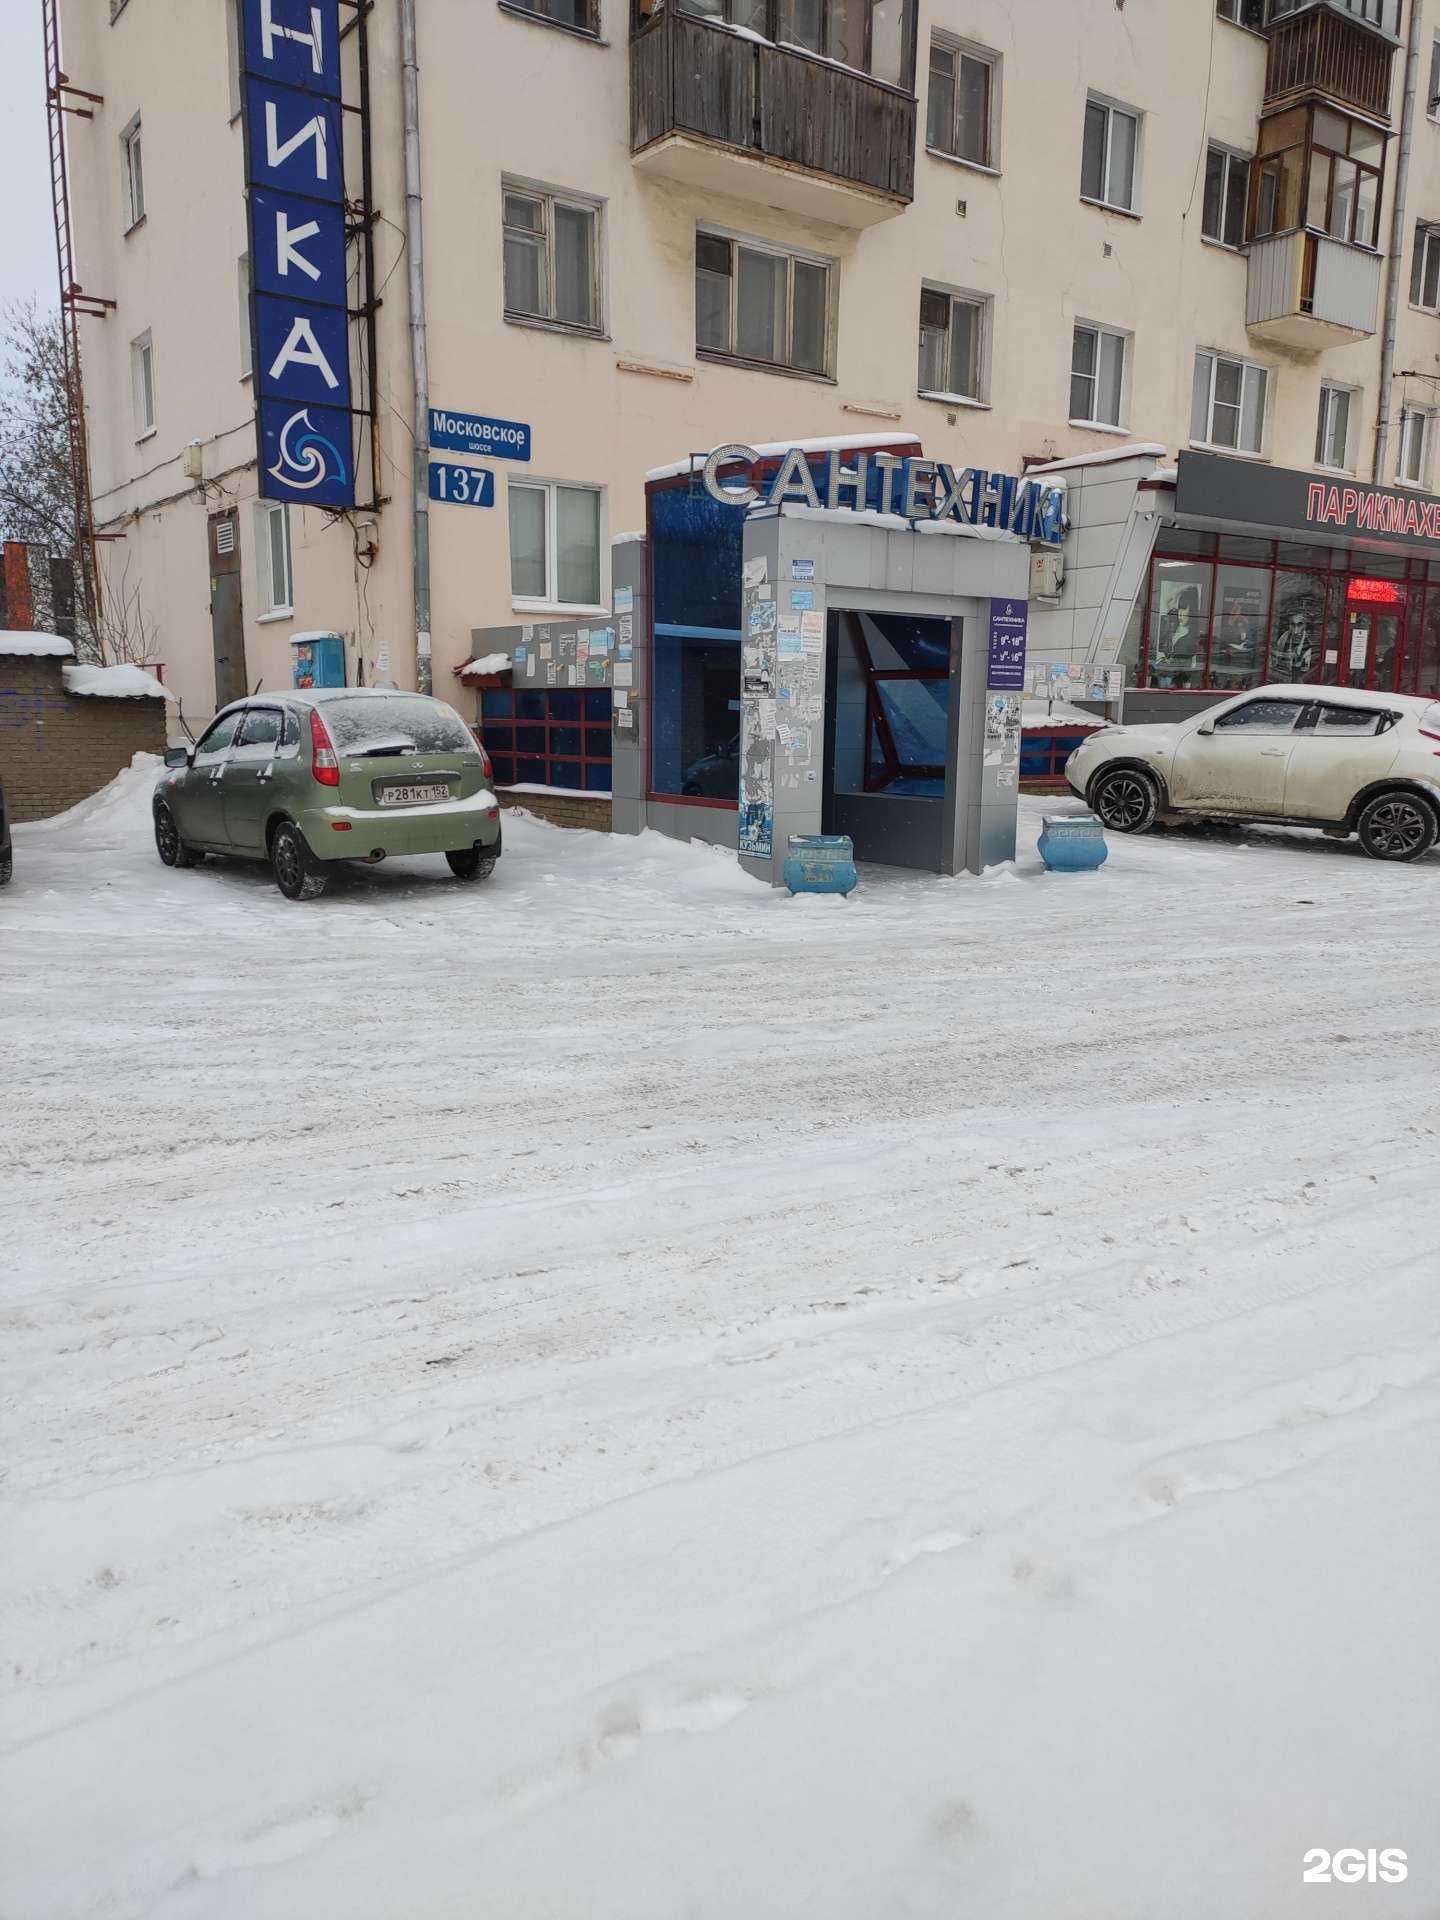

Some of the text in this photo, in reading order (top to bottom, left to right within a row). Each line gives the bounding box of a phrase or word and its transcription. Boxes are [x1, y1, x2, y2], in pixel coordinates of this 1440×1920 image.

[433, 412, 525, 445] Московское
[468, 442, 493, 453] шоссе
[437, 467, 486, 503] 137
[431, 786, 446, 795] 152
